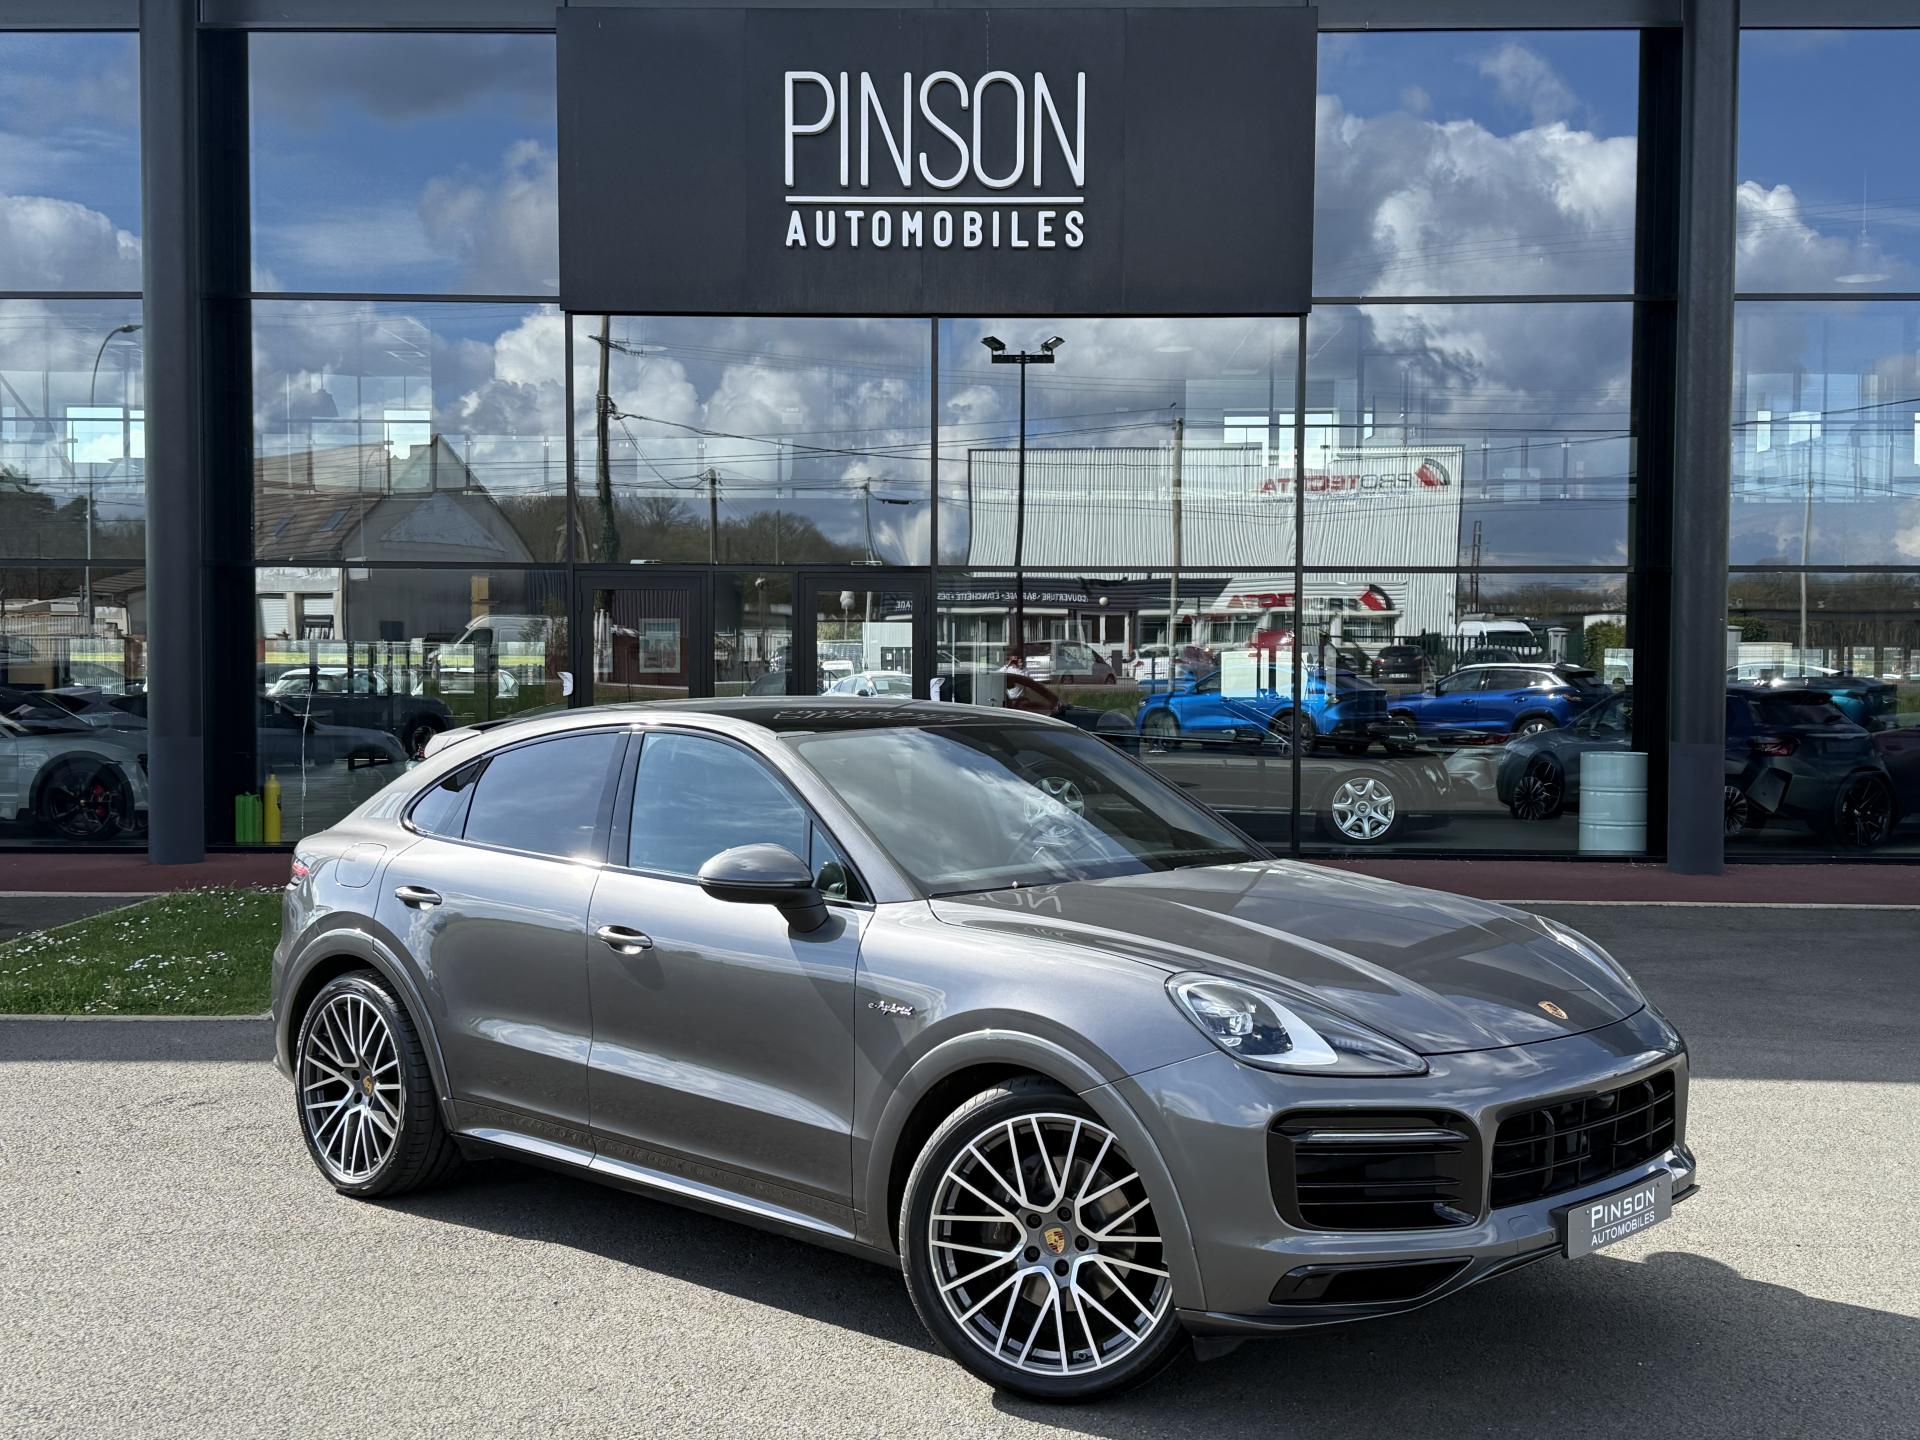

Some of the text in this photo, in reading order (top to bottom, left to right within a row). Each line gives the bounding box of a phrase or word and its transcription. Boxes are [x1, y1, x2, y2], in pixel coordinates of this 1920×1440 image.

[785, 71, 1086, 189] PINSON
[785, 210, 1085, 248] AUTOMOBILES
[1591, 1187, 1655, 1228] PINSON
[1591, 1211, 1655, 1246] AUTOMOBILES
